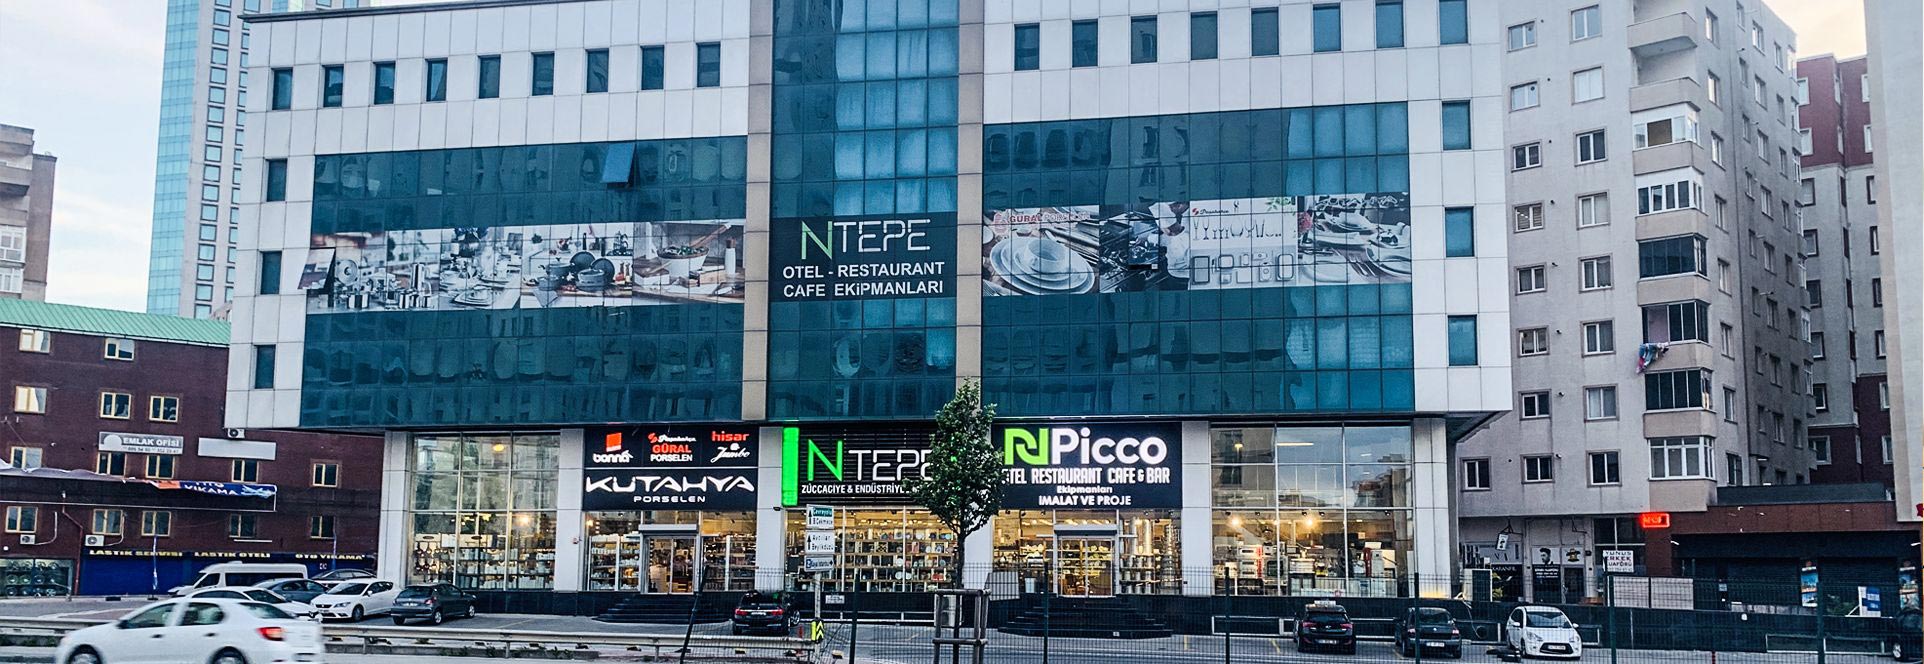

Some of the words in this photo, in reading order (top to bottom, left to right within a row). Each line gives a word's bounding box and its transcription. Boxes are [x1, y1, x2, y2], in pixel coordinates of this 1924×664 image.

[801, 218, 931, 260] NTEPE
[782, 265, 824, 279] OTEL
[837, 261, 945, 278] RESTAURANT
[783, 284, 826, 298] CAFE
[711, 430, 750, 441] hisar
[123, 436, 154, 447] EMLAK
[652, 443, 692, 454] GÜRAL
[650, 454, 693, 463] PORSELEN
[710, 447, 751, 464] Jumbo
[1031, 467, 1103, 485] RESTAURANT
[1106, 467, 1137, 485] CAFE
[1137, 470, 1145, 483] &
[1146, 467, 1171, 485] BAR
[848, 484, 854, 494] &
[633, 495, 706, 503] PORSELEN
[1080, 495, 1095, 506] VE
[1097, 495, 1132, 506] PROJE
